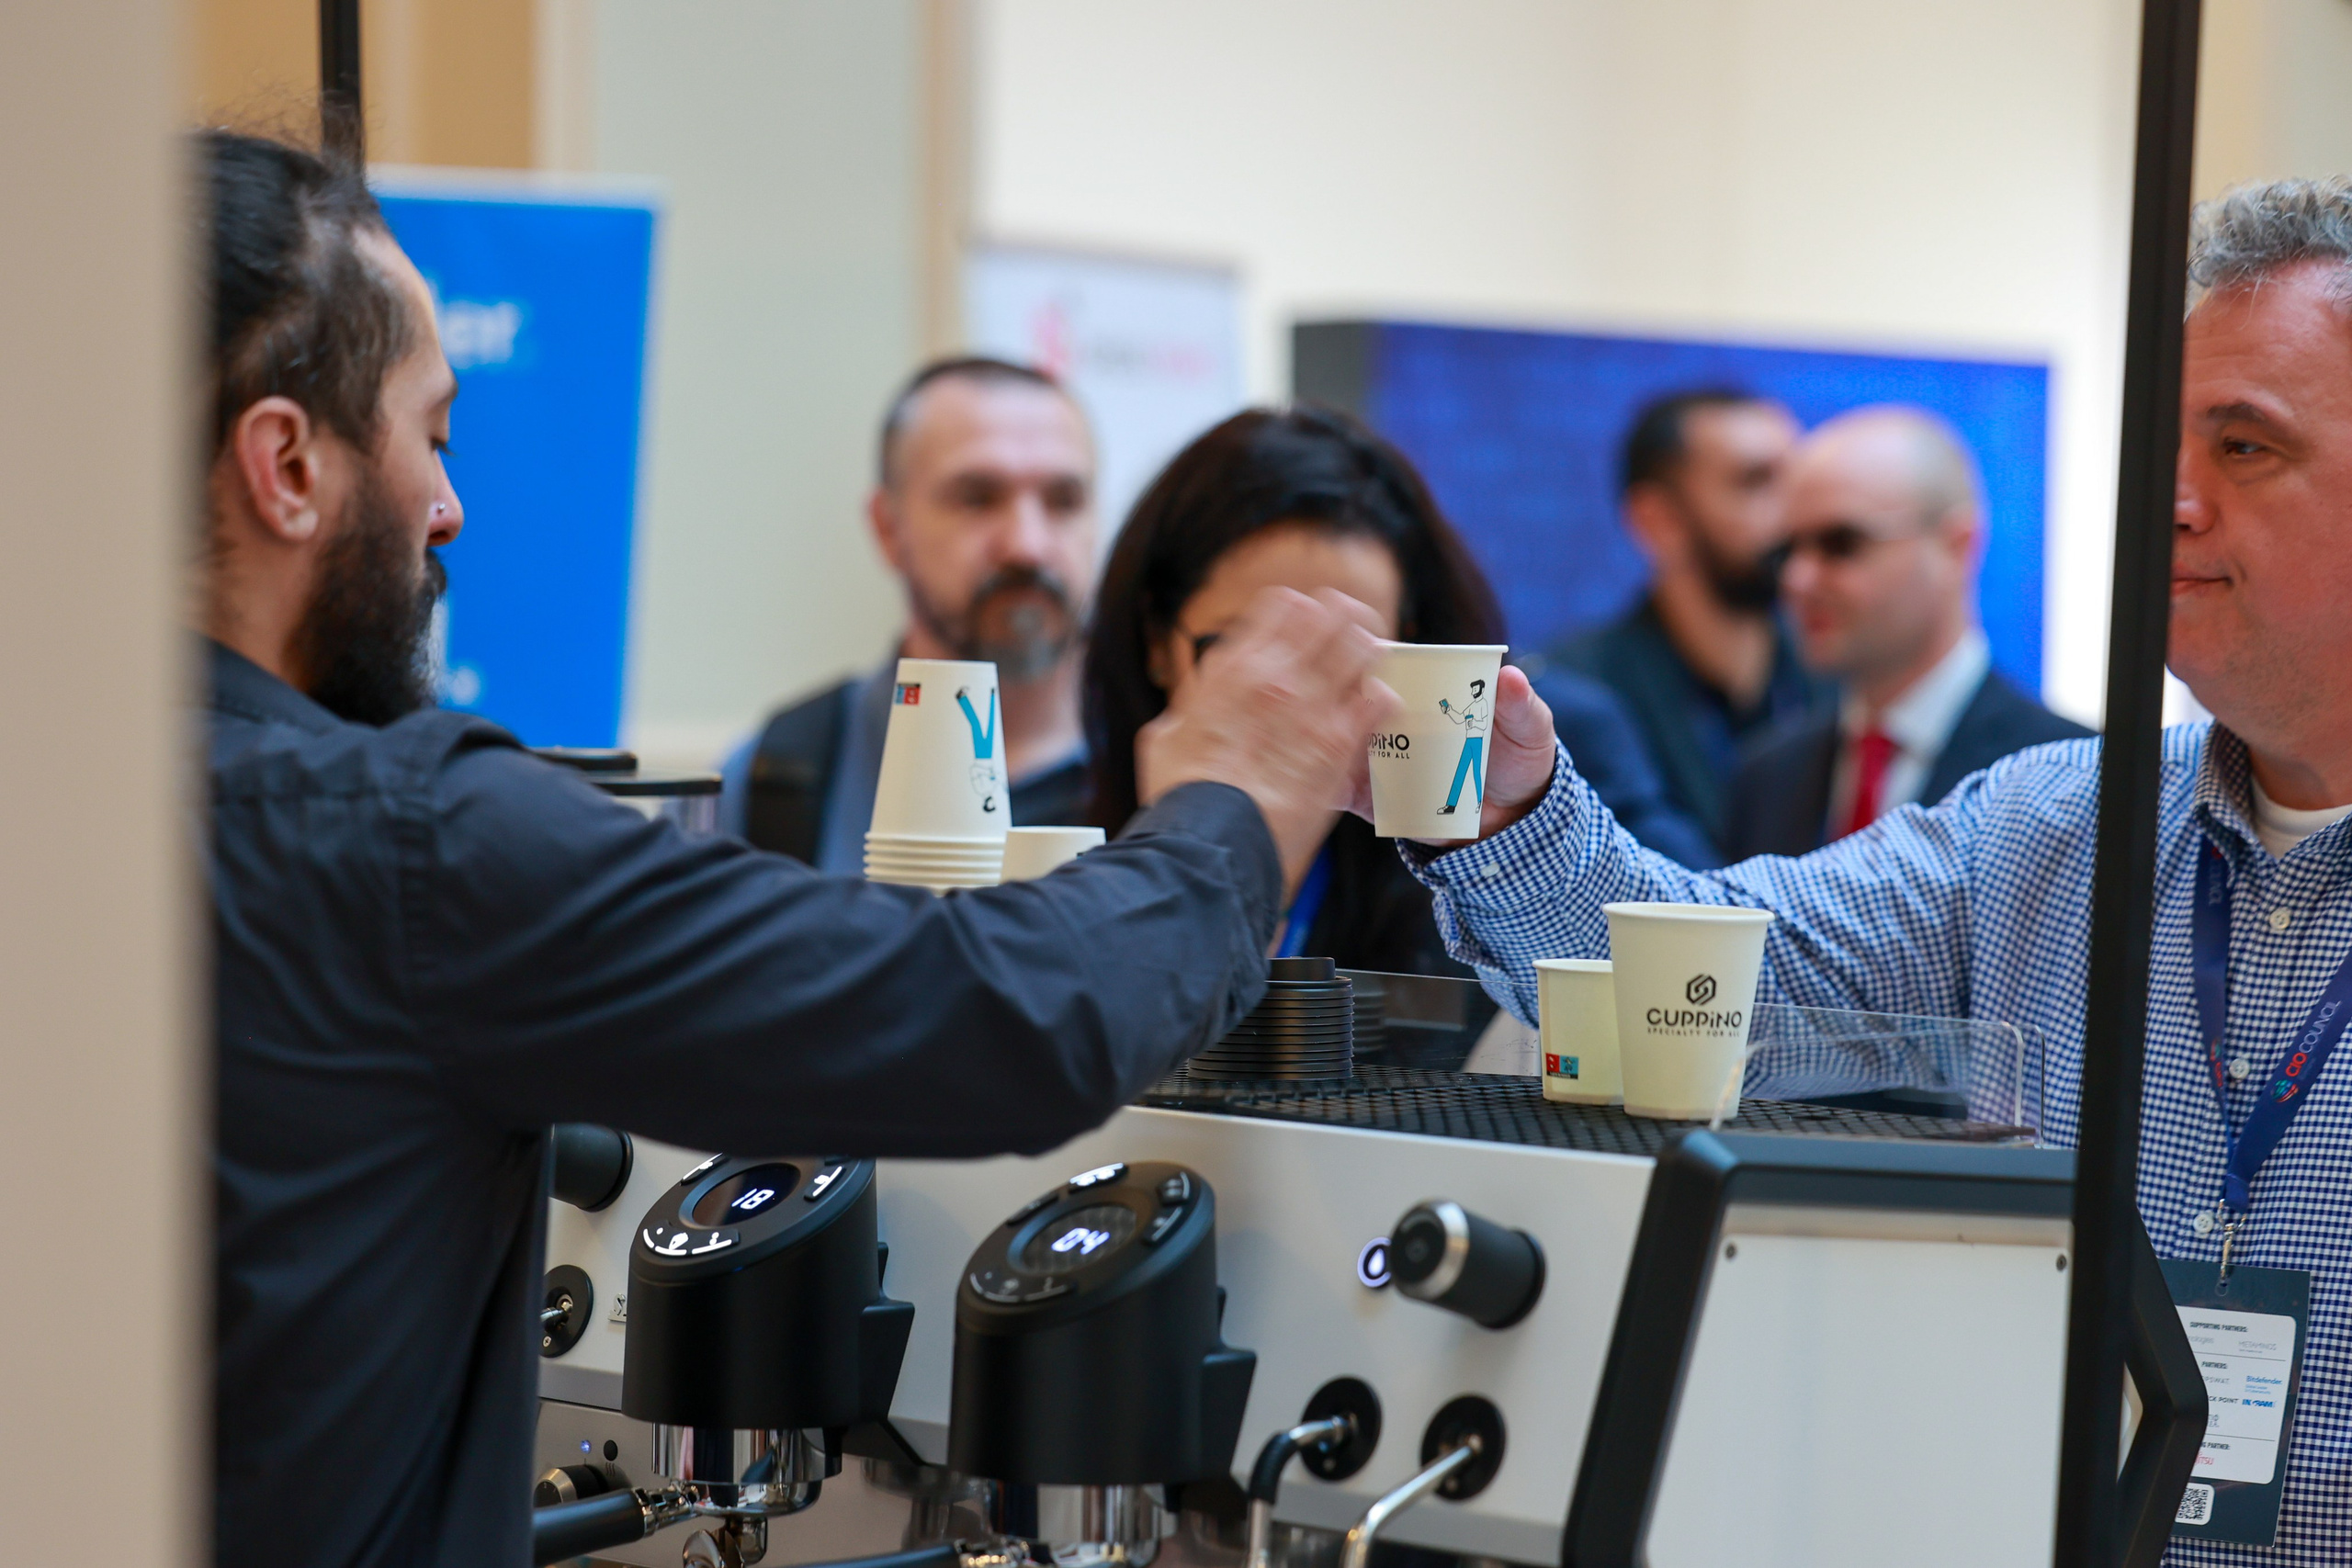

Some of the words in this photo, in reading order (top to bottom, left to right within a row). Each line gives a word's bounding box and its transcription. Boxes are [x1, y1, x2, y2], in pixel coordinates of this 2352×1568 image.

[1647, 1028, 1701, 1037] SPECIALTY
[731, 1188, 775, 1210] 18
[1051, 1227, 1111, 1256] 04
